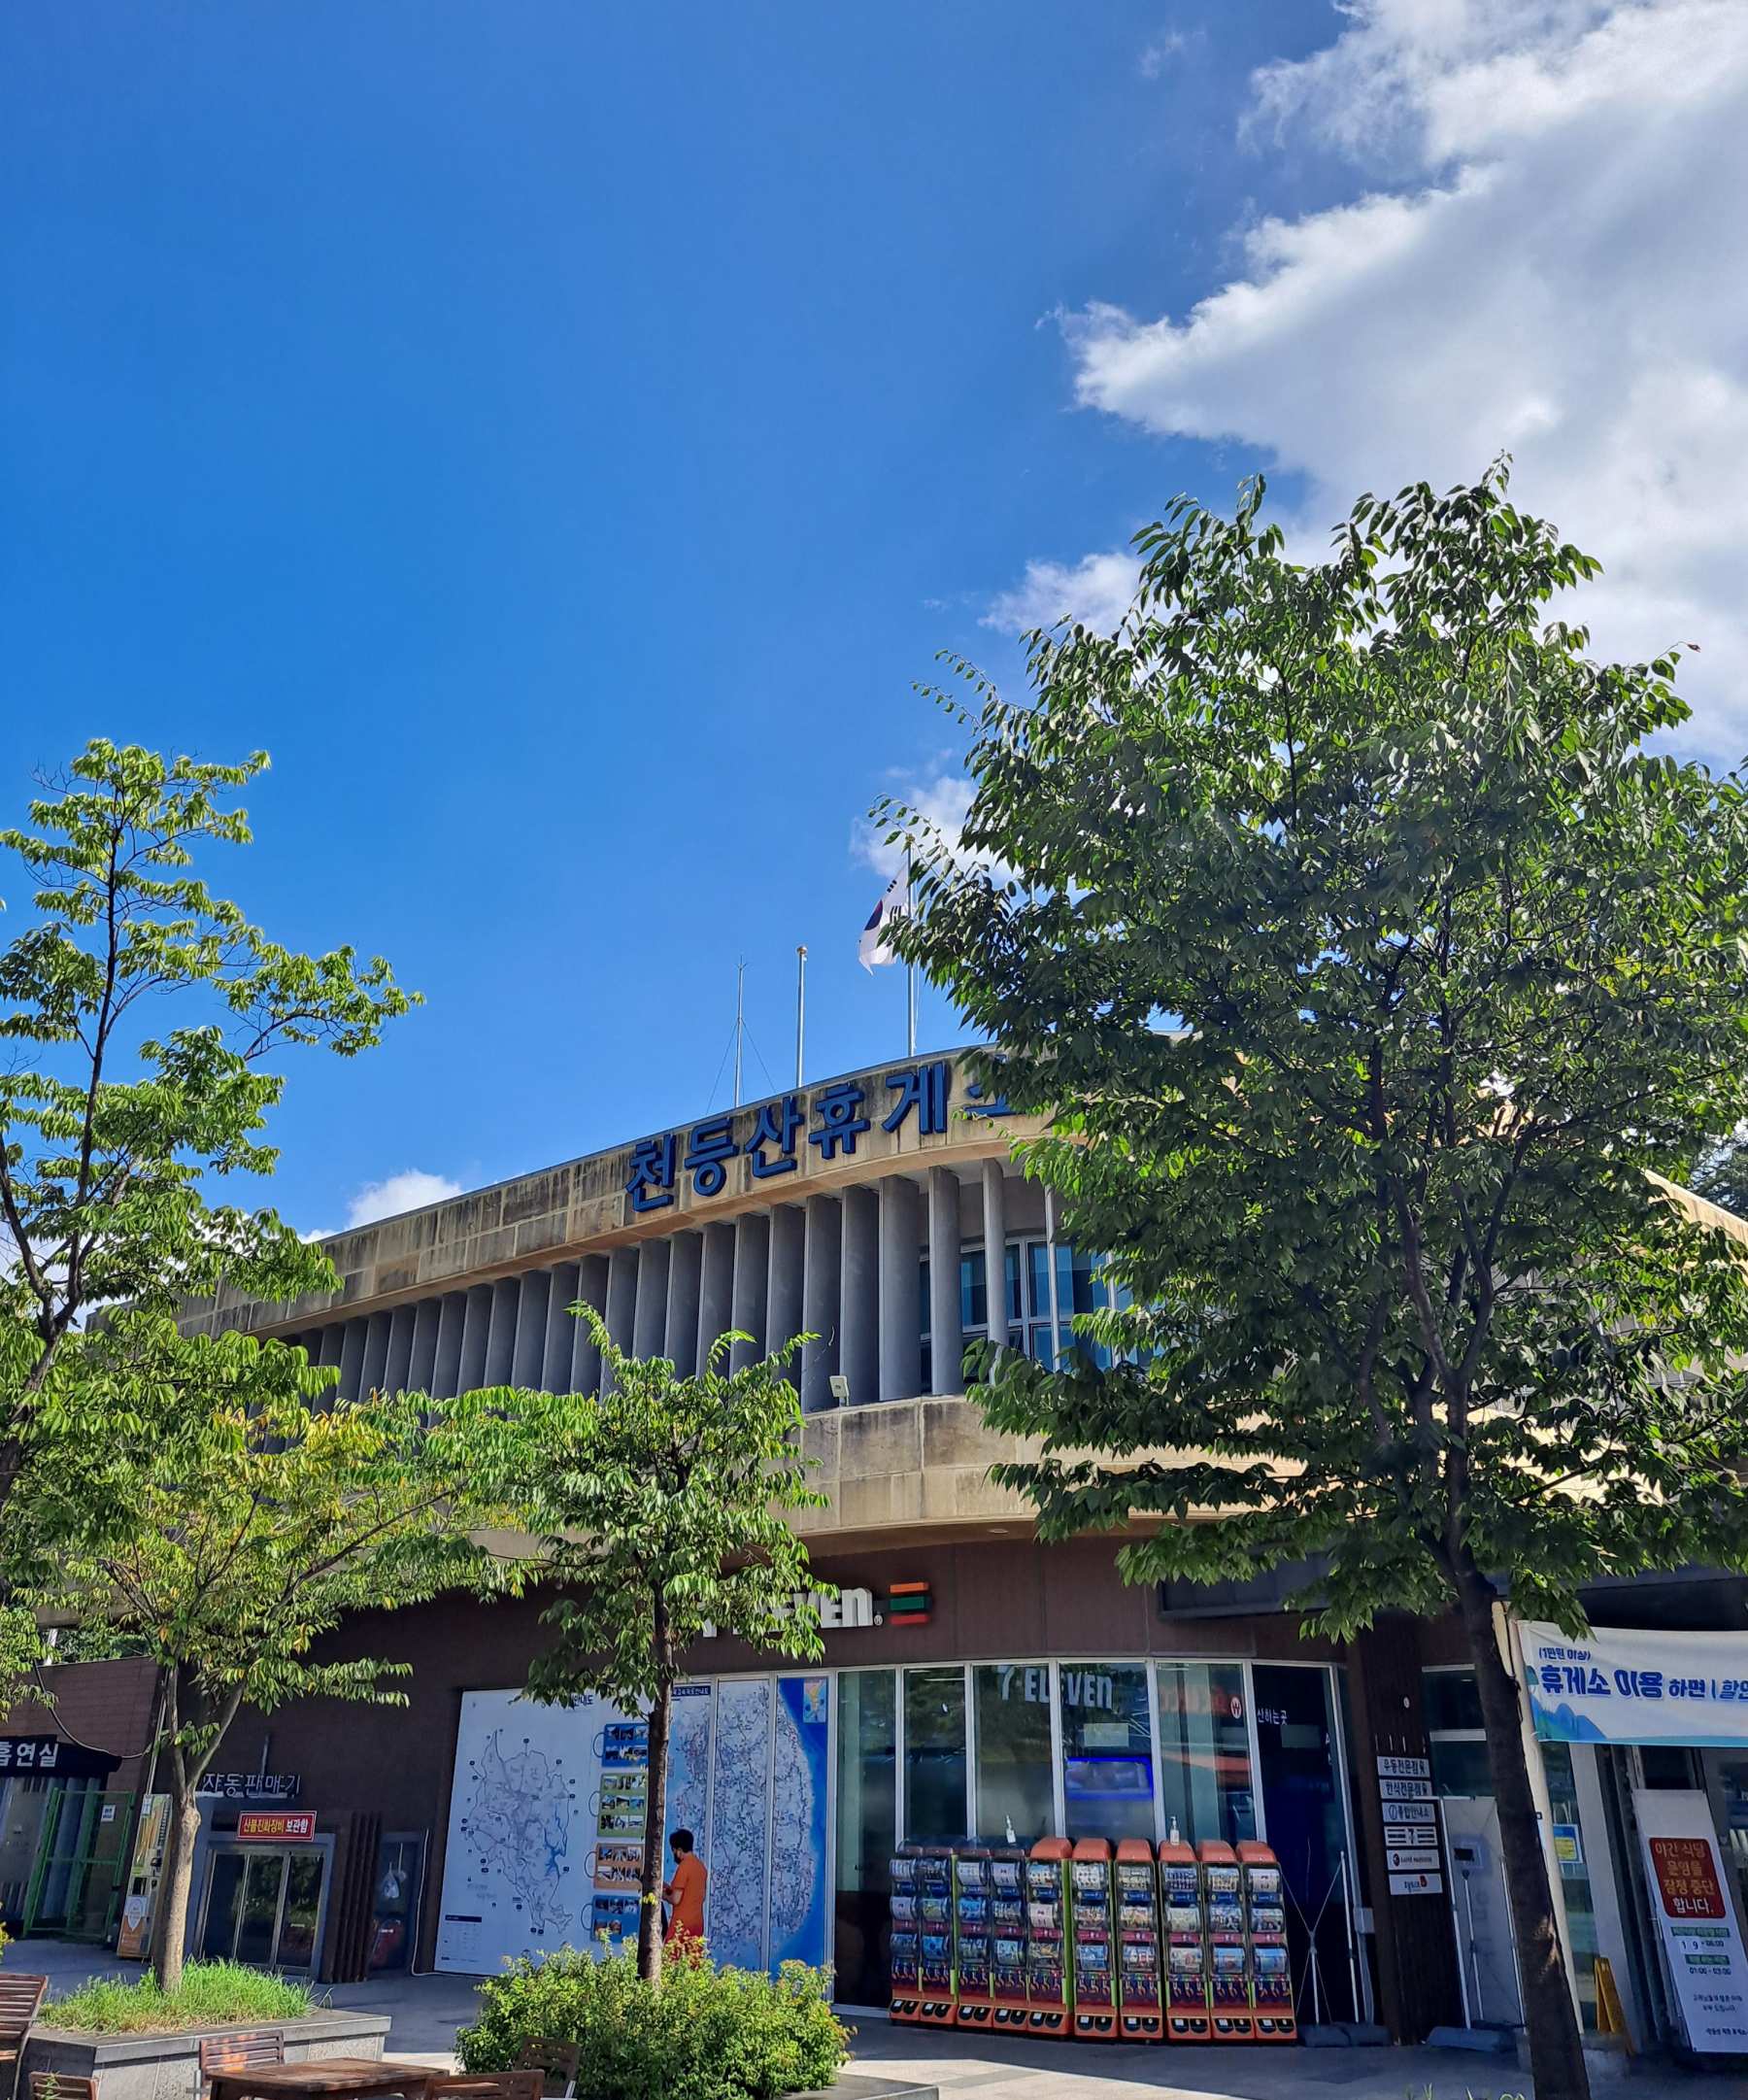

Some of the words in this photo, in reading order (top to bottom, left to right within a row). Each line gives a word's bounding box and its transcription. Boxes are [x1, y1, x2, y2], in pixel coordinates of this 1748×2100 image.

[1540, 1665, 1611, 1695] 휴게소
[1614, 1670, 1664, 1698] 이용
[1668, 1678, 1705, 1698] 하면
[201, 1773, 301, 1797] 자동판매기
[286, 1817, 308, 1834] 보관함
